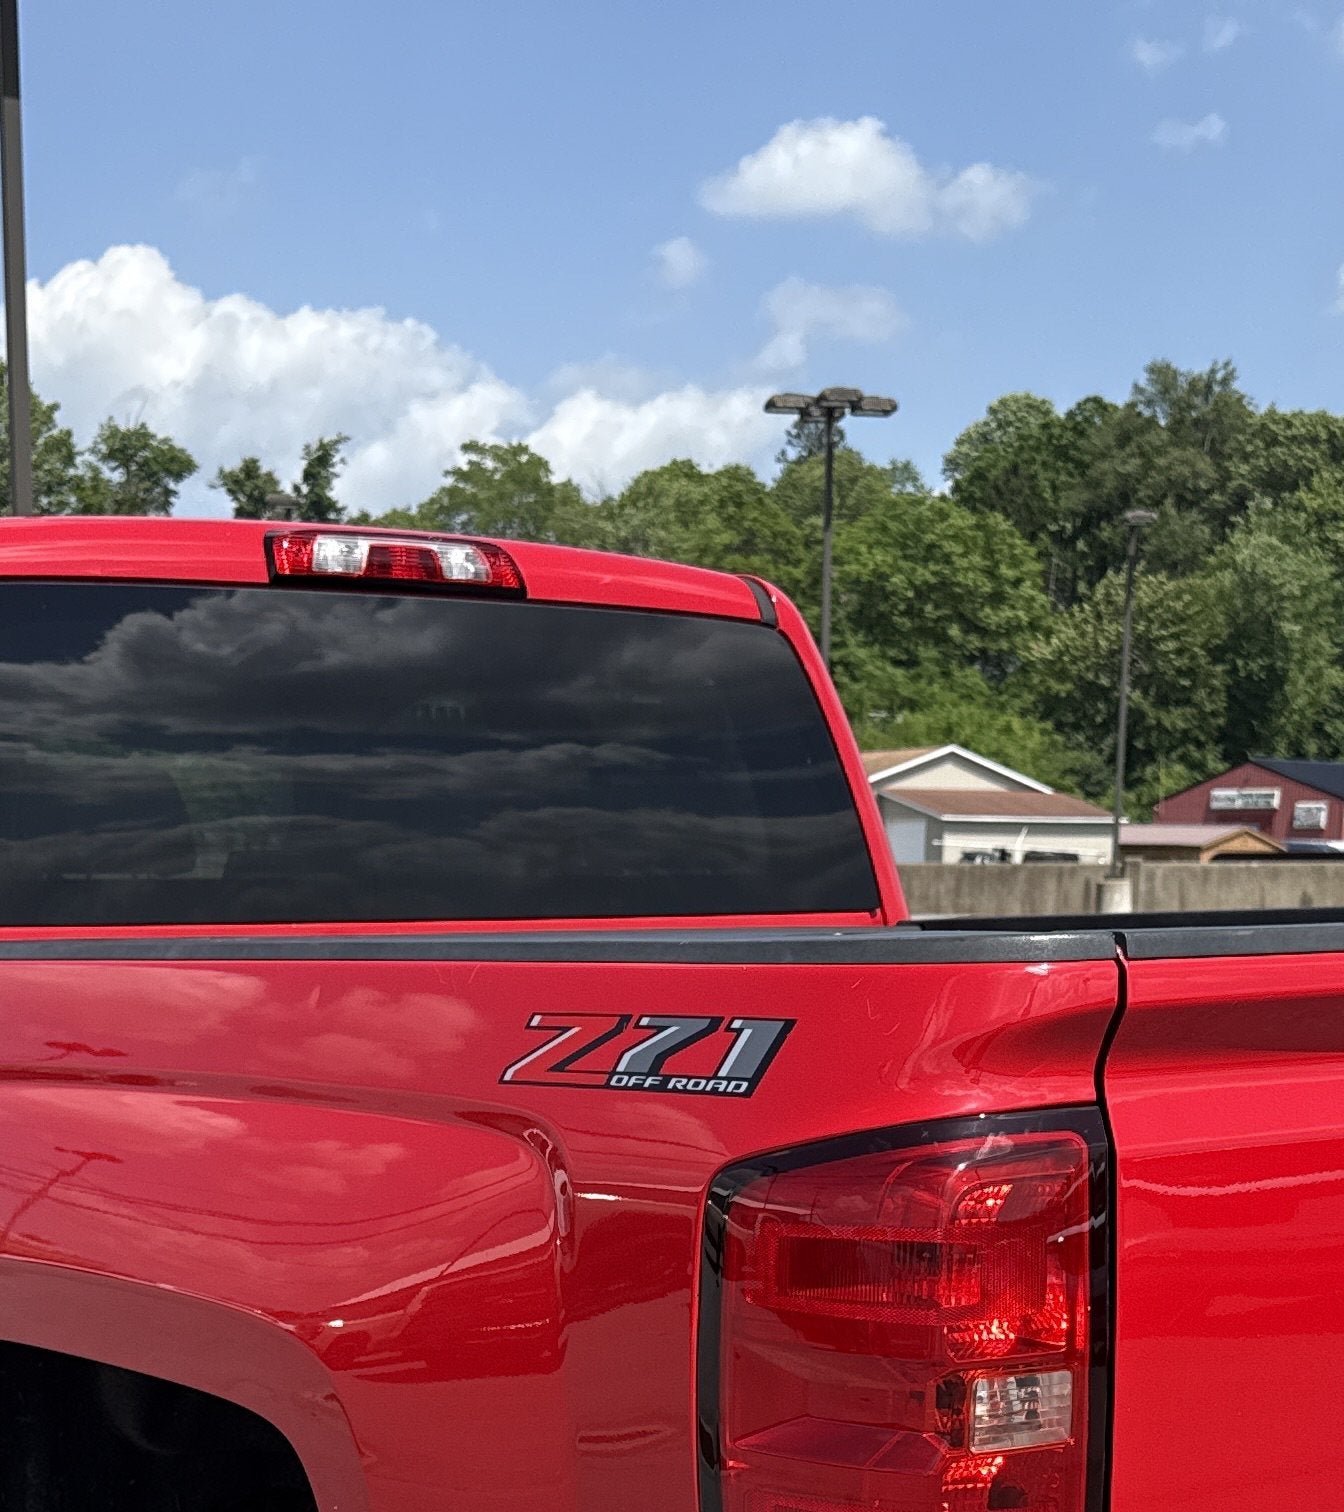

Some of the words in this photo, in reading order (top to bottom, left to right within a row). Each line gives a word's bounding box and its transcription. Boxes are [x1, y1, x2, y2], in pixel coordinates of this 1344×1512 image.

[498, 1012, 798, 1086] Z71
[609, 1074, 663, 1089] OFF
[667, 1077, 750, 1094] ROAD
